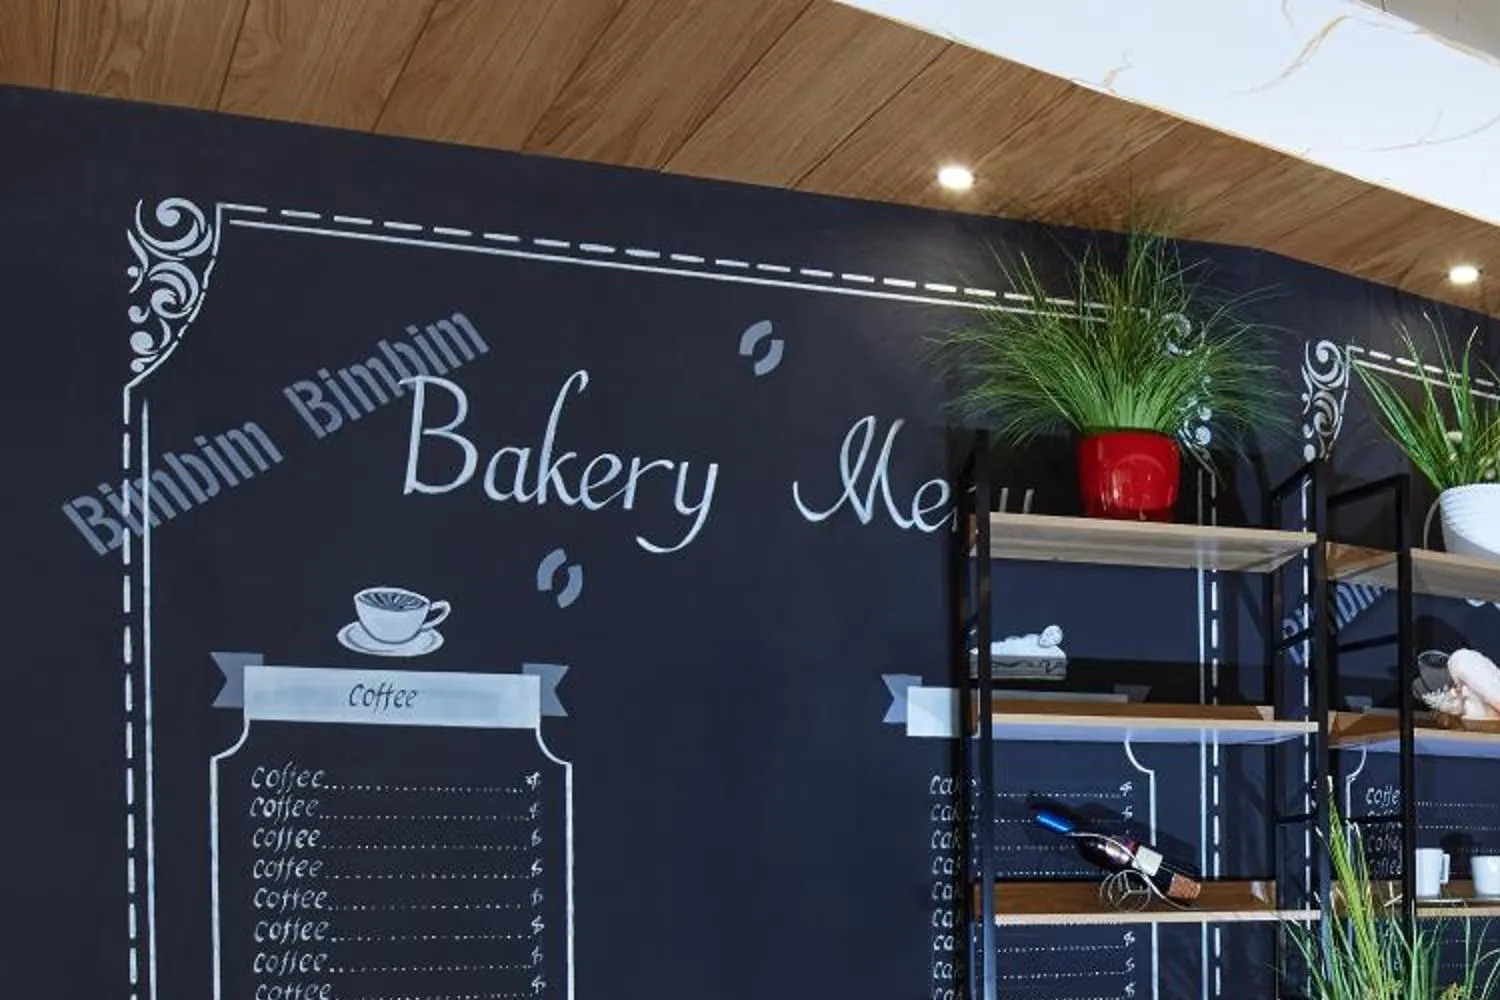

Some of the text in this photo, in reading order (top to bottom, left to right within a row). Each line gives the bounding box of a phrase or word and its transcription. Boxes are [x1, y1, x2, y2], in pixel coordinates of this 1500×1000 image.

[62, 311, 489, 556] Bimbim Bimbim
[398, 369, 1034, 554] Bakery Me
[348, 682, 417, 709] Coffee
